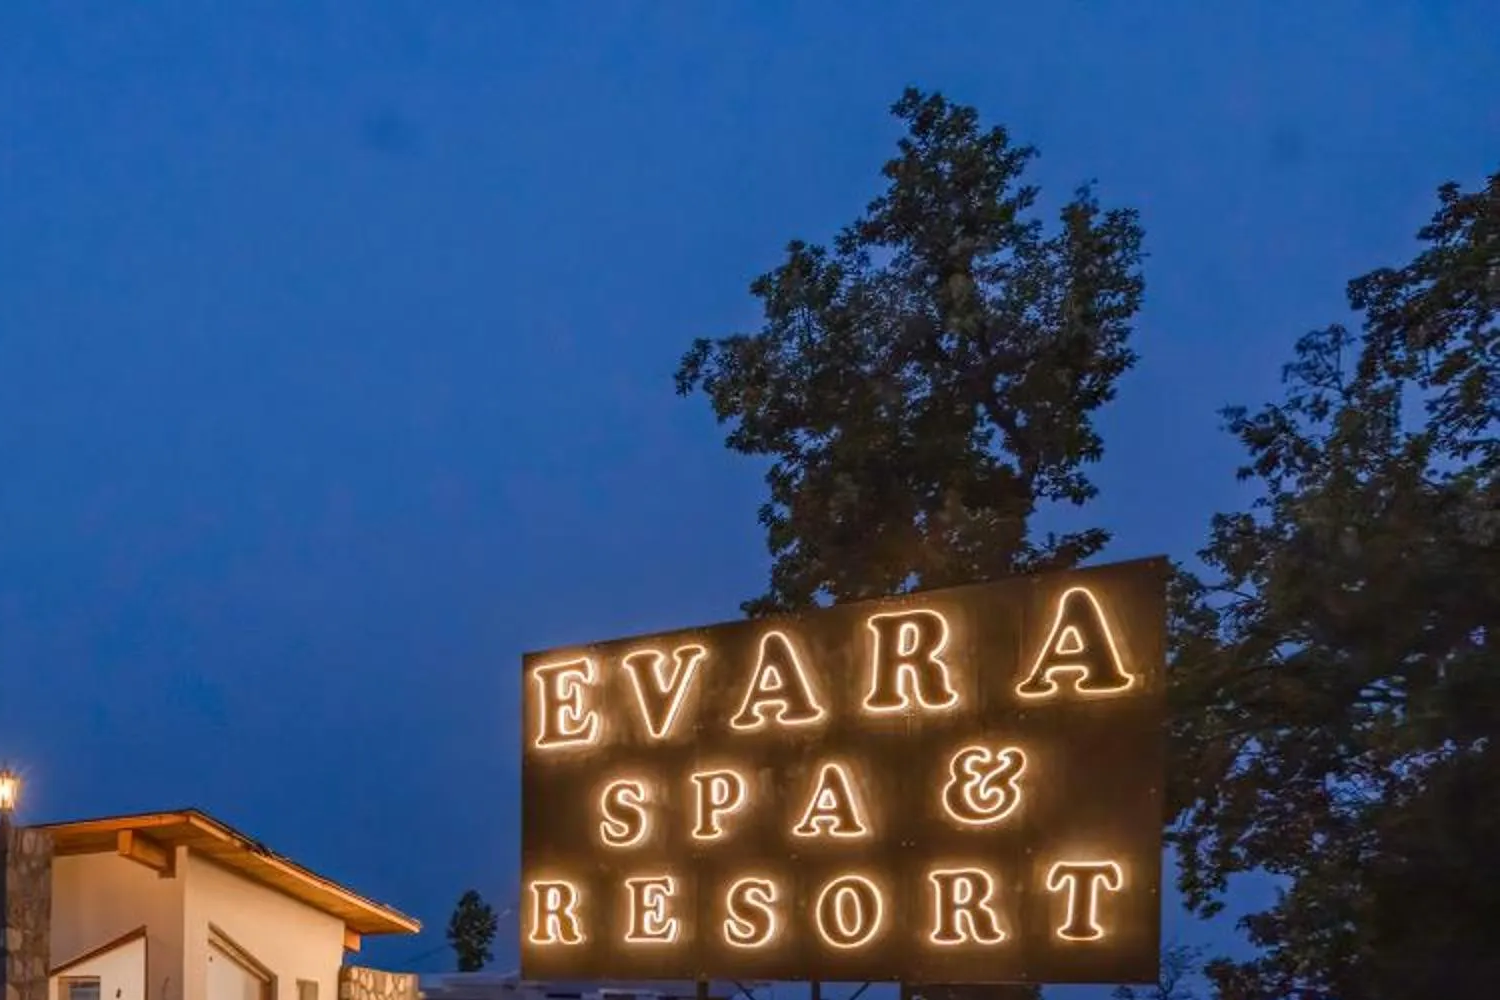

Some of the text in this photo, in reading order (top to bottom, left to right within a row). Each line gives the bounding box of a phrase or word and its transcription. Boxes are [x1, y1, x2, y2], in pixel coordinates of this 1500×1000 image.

[533, 586, 1135, 748] EVARA
[600, 744, 1028, 847] SPA &
[529, 860, 1124, 949] RESORT
